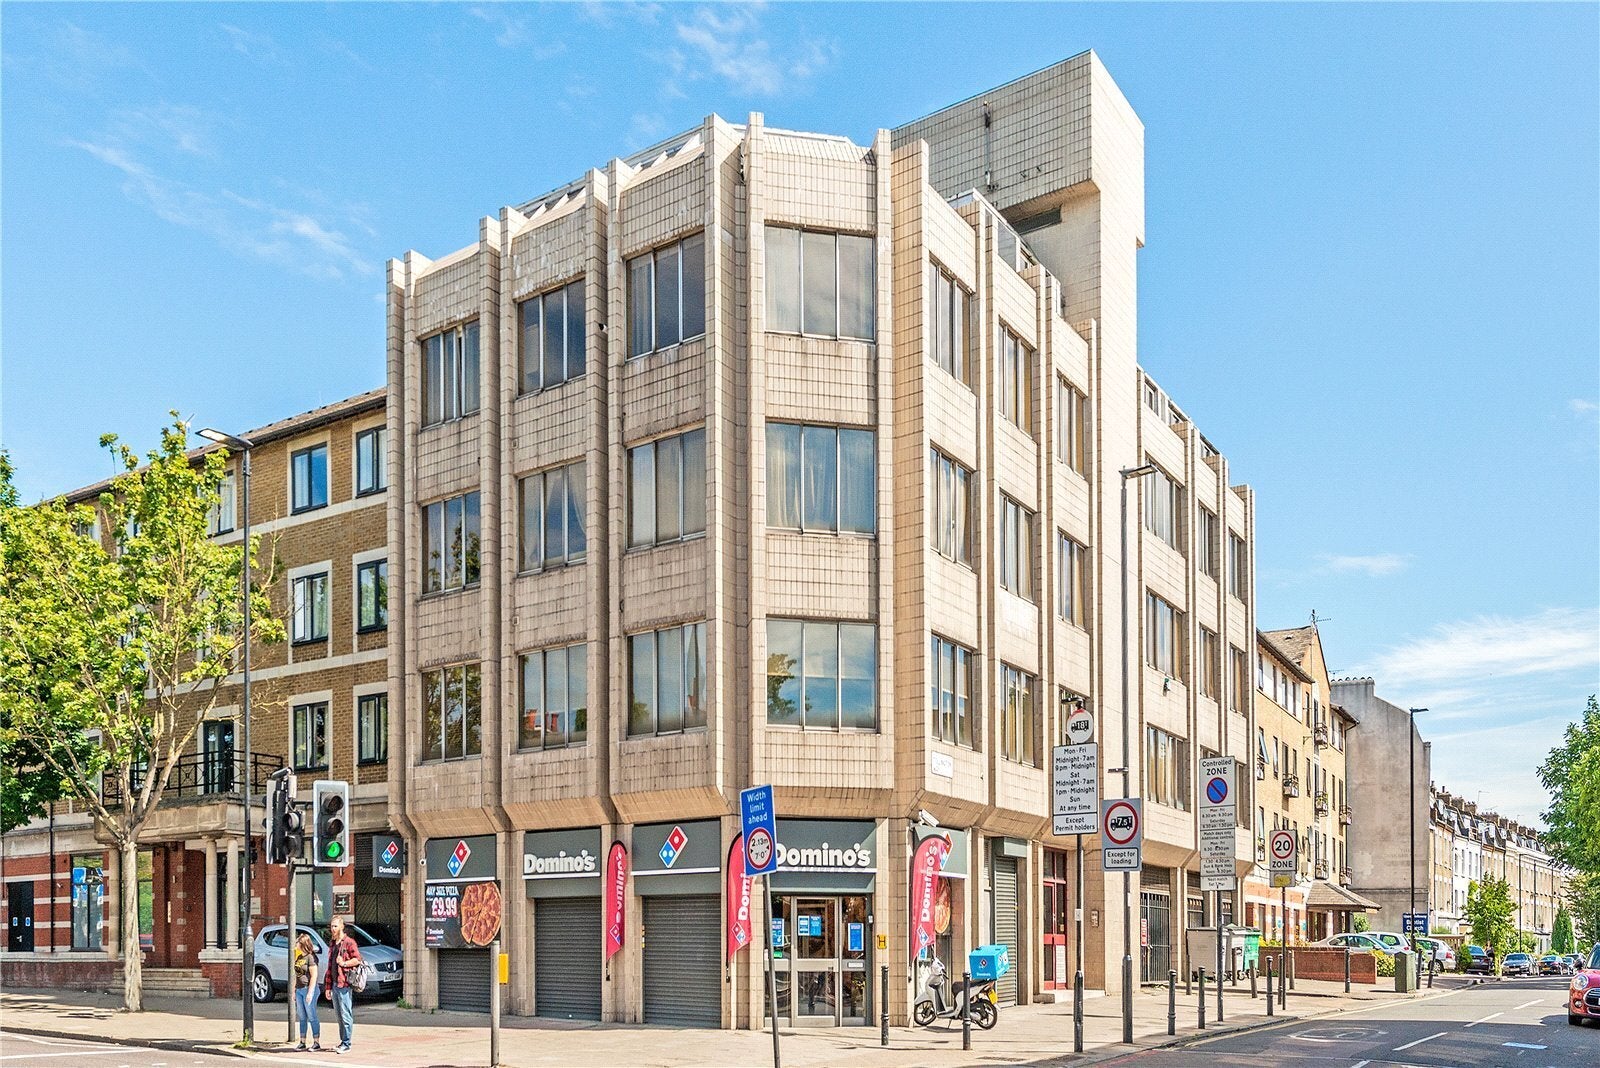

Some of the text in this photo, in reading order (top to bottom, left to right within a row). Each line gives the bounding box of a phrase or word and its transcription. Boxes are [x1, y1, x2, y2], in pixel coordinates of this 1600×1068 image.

[1207, 767, 1227, 775] ZONE
[747, 791, 766, 802] Width
[750, 802, 765, 813] limit
[748, 812, 768, 824] ahead
[1275, 840, 1290, 851] 20
[776, 842, 871, 867] Domino's
[524, 849, 596, 873] Domino's
[379, 866, 401, 874] Domino's
[921, 846, 937, 922] Domino's
[432, 897, 458, 918] £9.99
